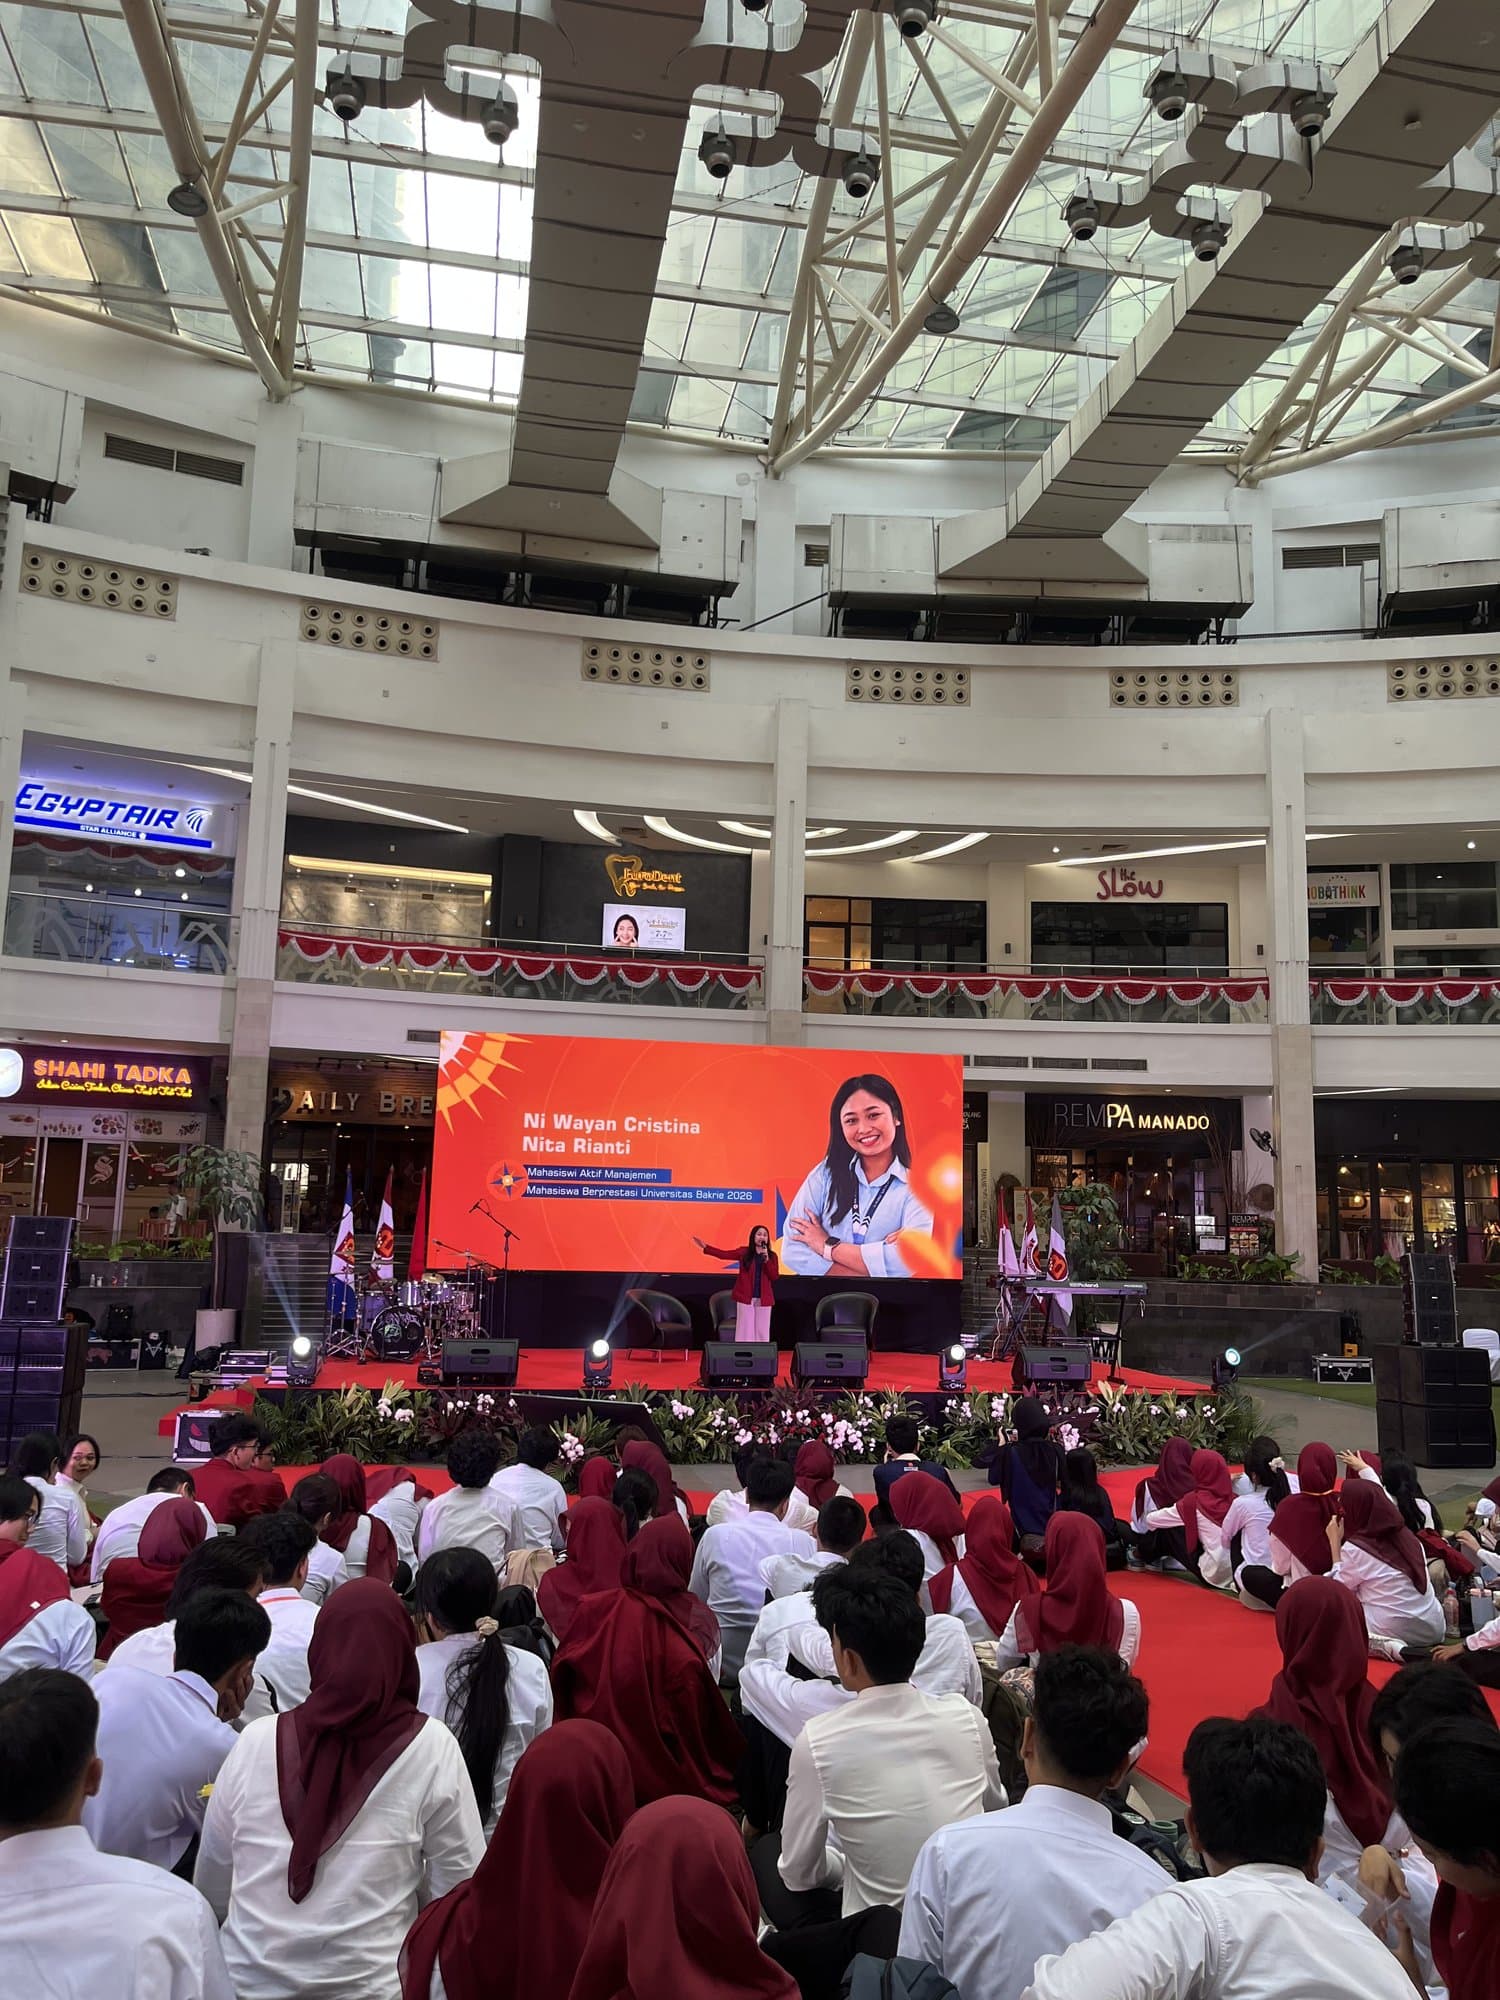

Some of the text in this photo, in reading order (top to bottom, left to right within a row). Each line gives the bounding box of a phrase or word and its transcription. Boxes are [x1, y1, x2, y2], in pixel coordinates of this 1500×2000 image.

[16, 783, 180, 829] EGYPTAIR
[80, 824, 138, 838] STAR ALLIANCE
[33, 1059, 192, 1084] SHAHI TADKA
[523, 1112, 701, 1135] Ni Wayan Cristina
[1054, 1103, 1210, 1130] REMPA MANADO
[522, 1136, 631, 1155] Nita Rianti
[527, 1167, 657, 1181] Mahasiswi Aktif Manajemen
[526, 1185, 753, 1201] Mahasiswa Berprestasi Universitas Bakrie 2026
